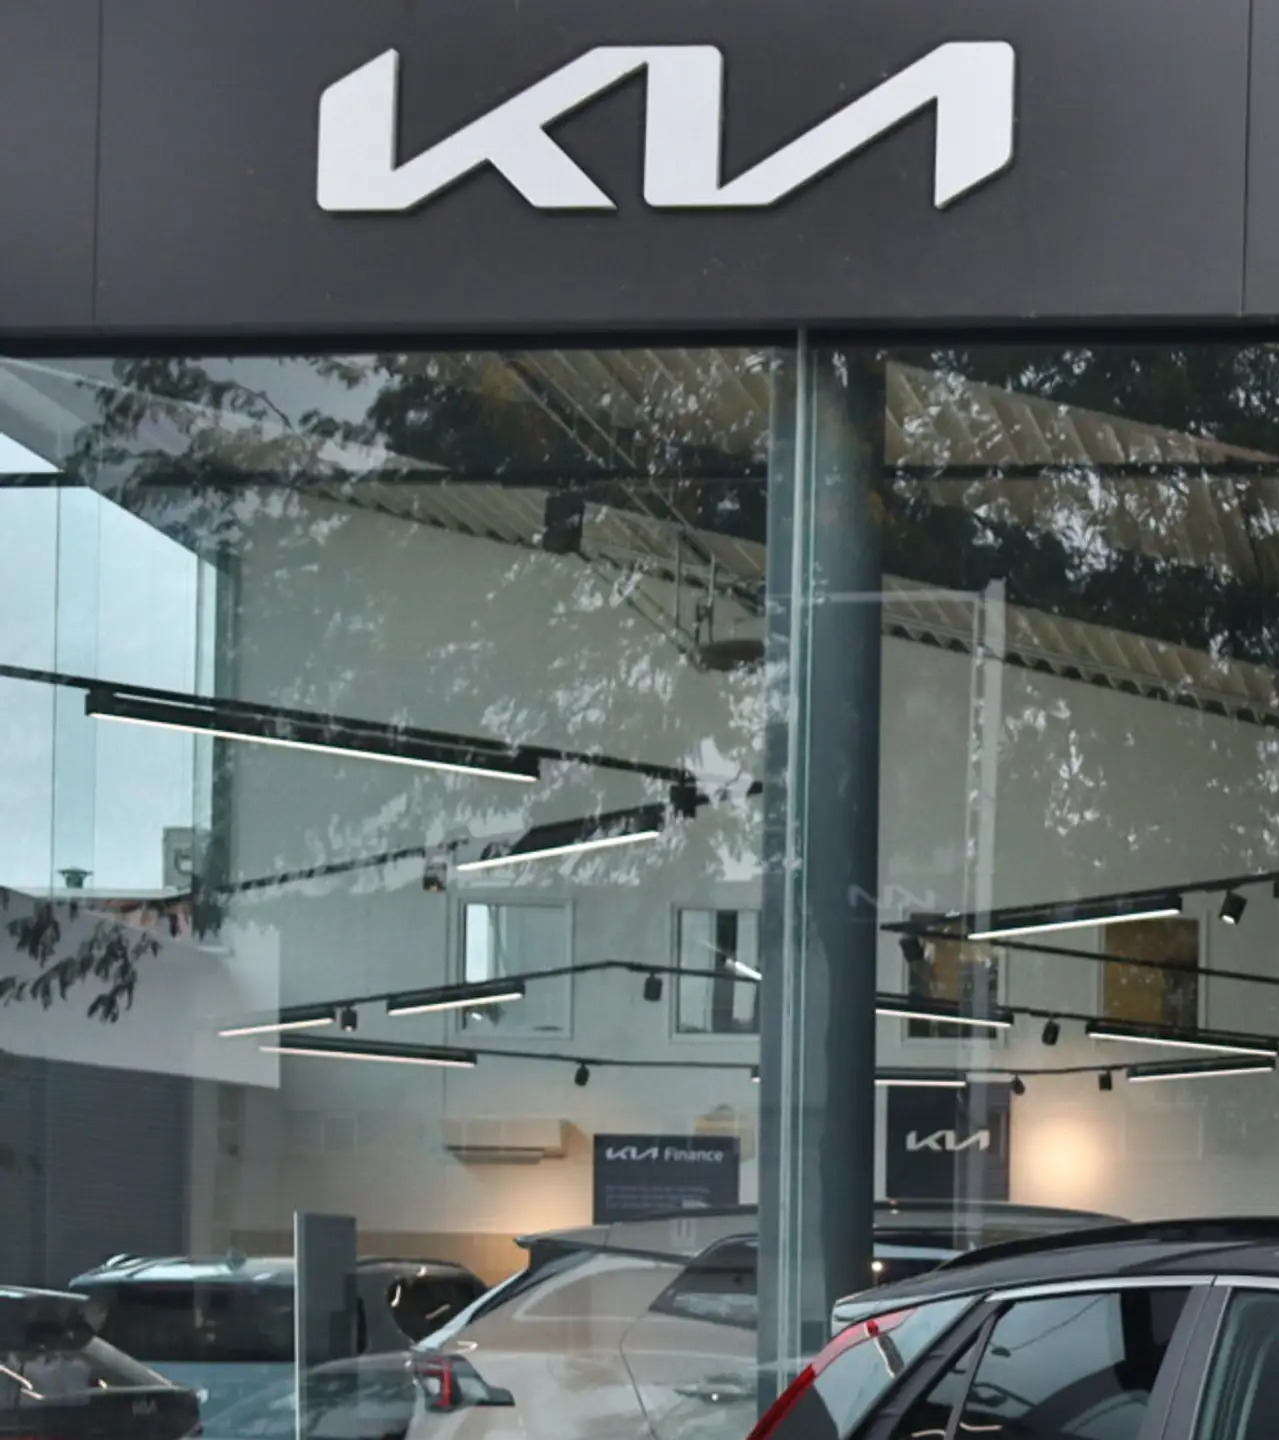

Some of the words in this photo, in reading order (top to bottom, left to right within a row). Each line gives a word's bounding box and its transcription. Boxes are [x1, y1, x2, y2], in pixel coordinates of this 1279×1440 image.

[317, 41, 1014, 211] KIA
[905, 1130, 991, 1151] KIA
[605, 1146, 659, 1161] KIA
[663, 1146, 724, 1163] Finance
